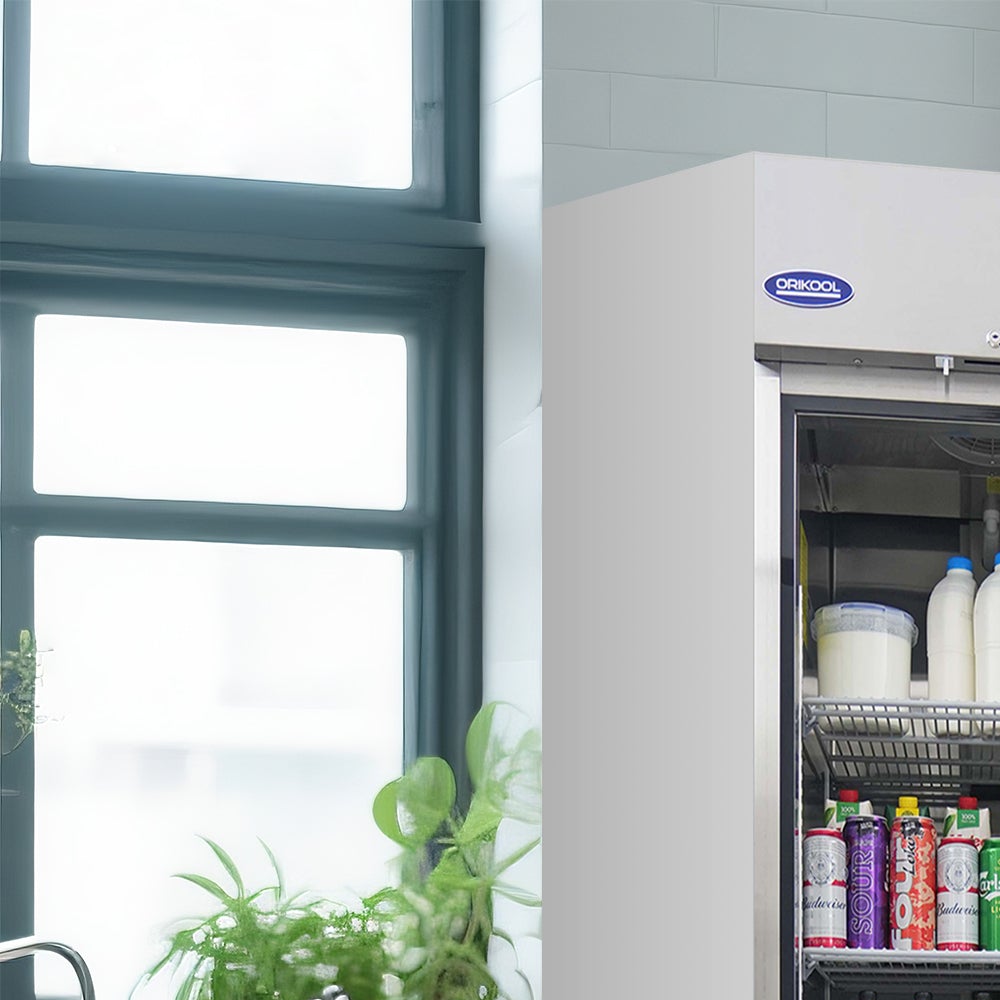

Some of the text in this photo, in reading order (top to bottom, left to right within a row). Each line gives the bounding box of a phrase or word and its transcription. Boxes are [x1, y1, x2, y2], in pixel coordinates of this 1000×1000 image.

[776, 278, 841, 293] ORIKOOL
[902, 836, 917, 877] Loko
[850, 850, 874, 935] SOUR
